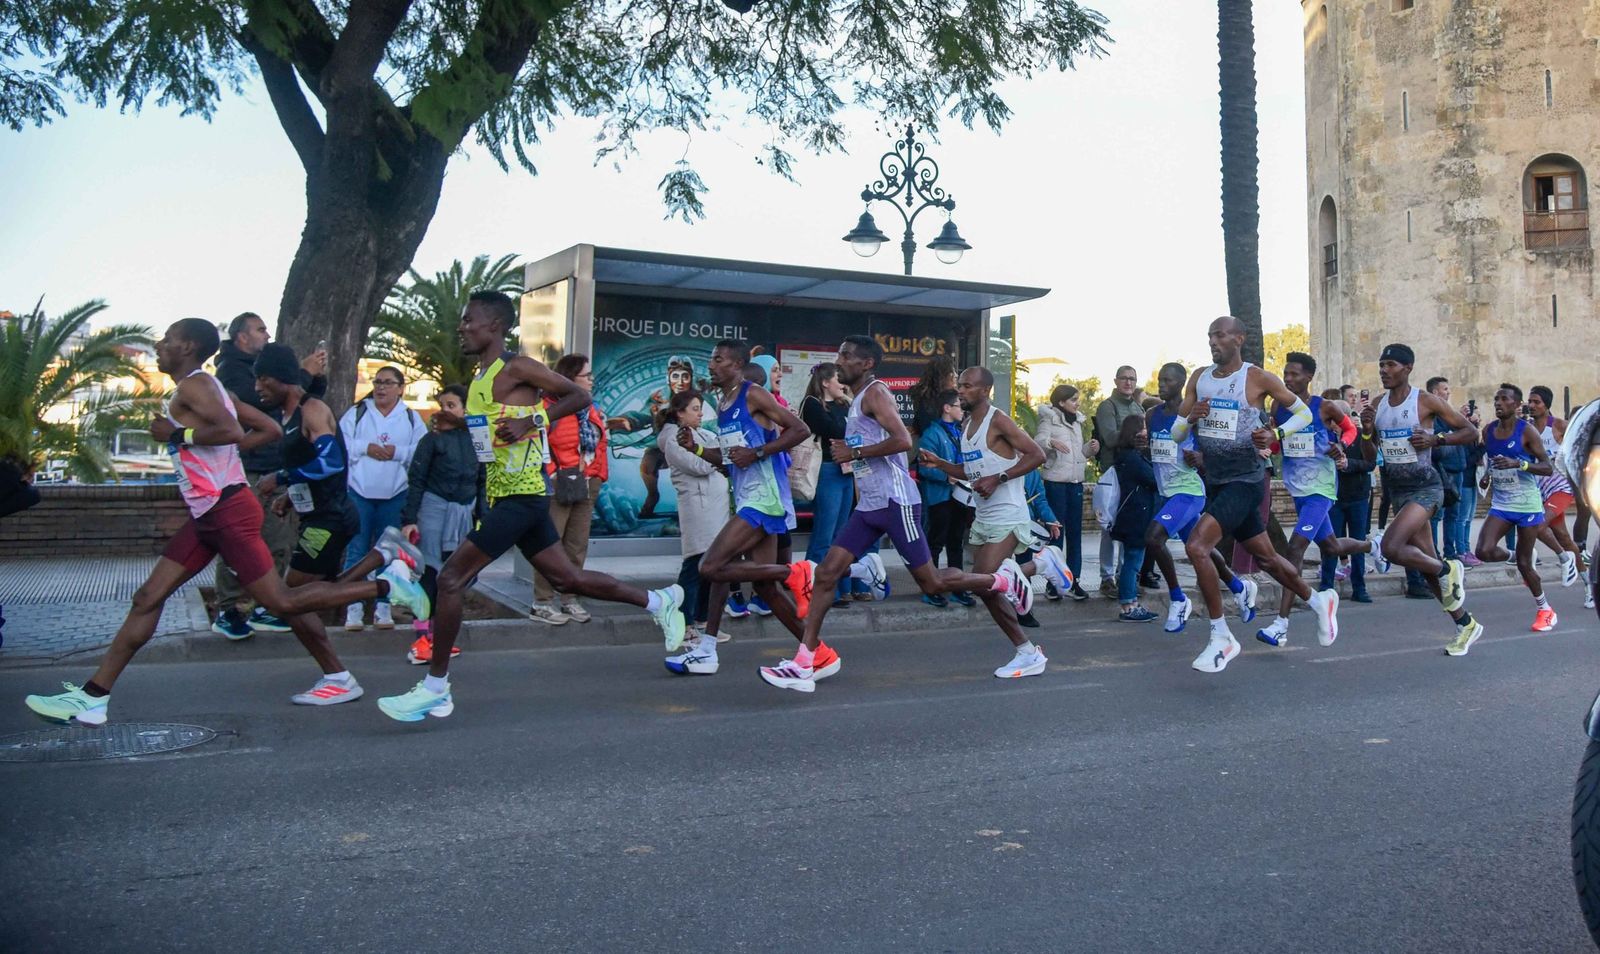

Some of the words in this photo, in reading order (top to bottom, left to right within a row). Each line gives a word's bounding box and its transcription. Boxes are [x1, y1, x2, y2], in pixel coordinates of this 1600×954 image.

[659, 321, 684, 337] DU
[689, 323, 748, 341] SOLEIL
[1210, 400, 1234, 409] ZURICH
[1203, 419, 1230, 430] TARESA
[1387, 430, 1408, 438] ZURICH
[1386, 448, 1409, 456] FEYISA
